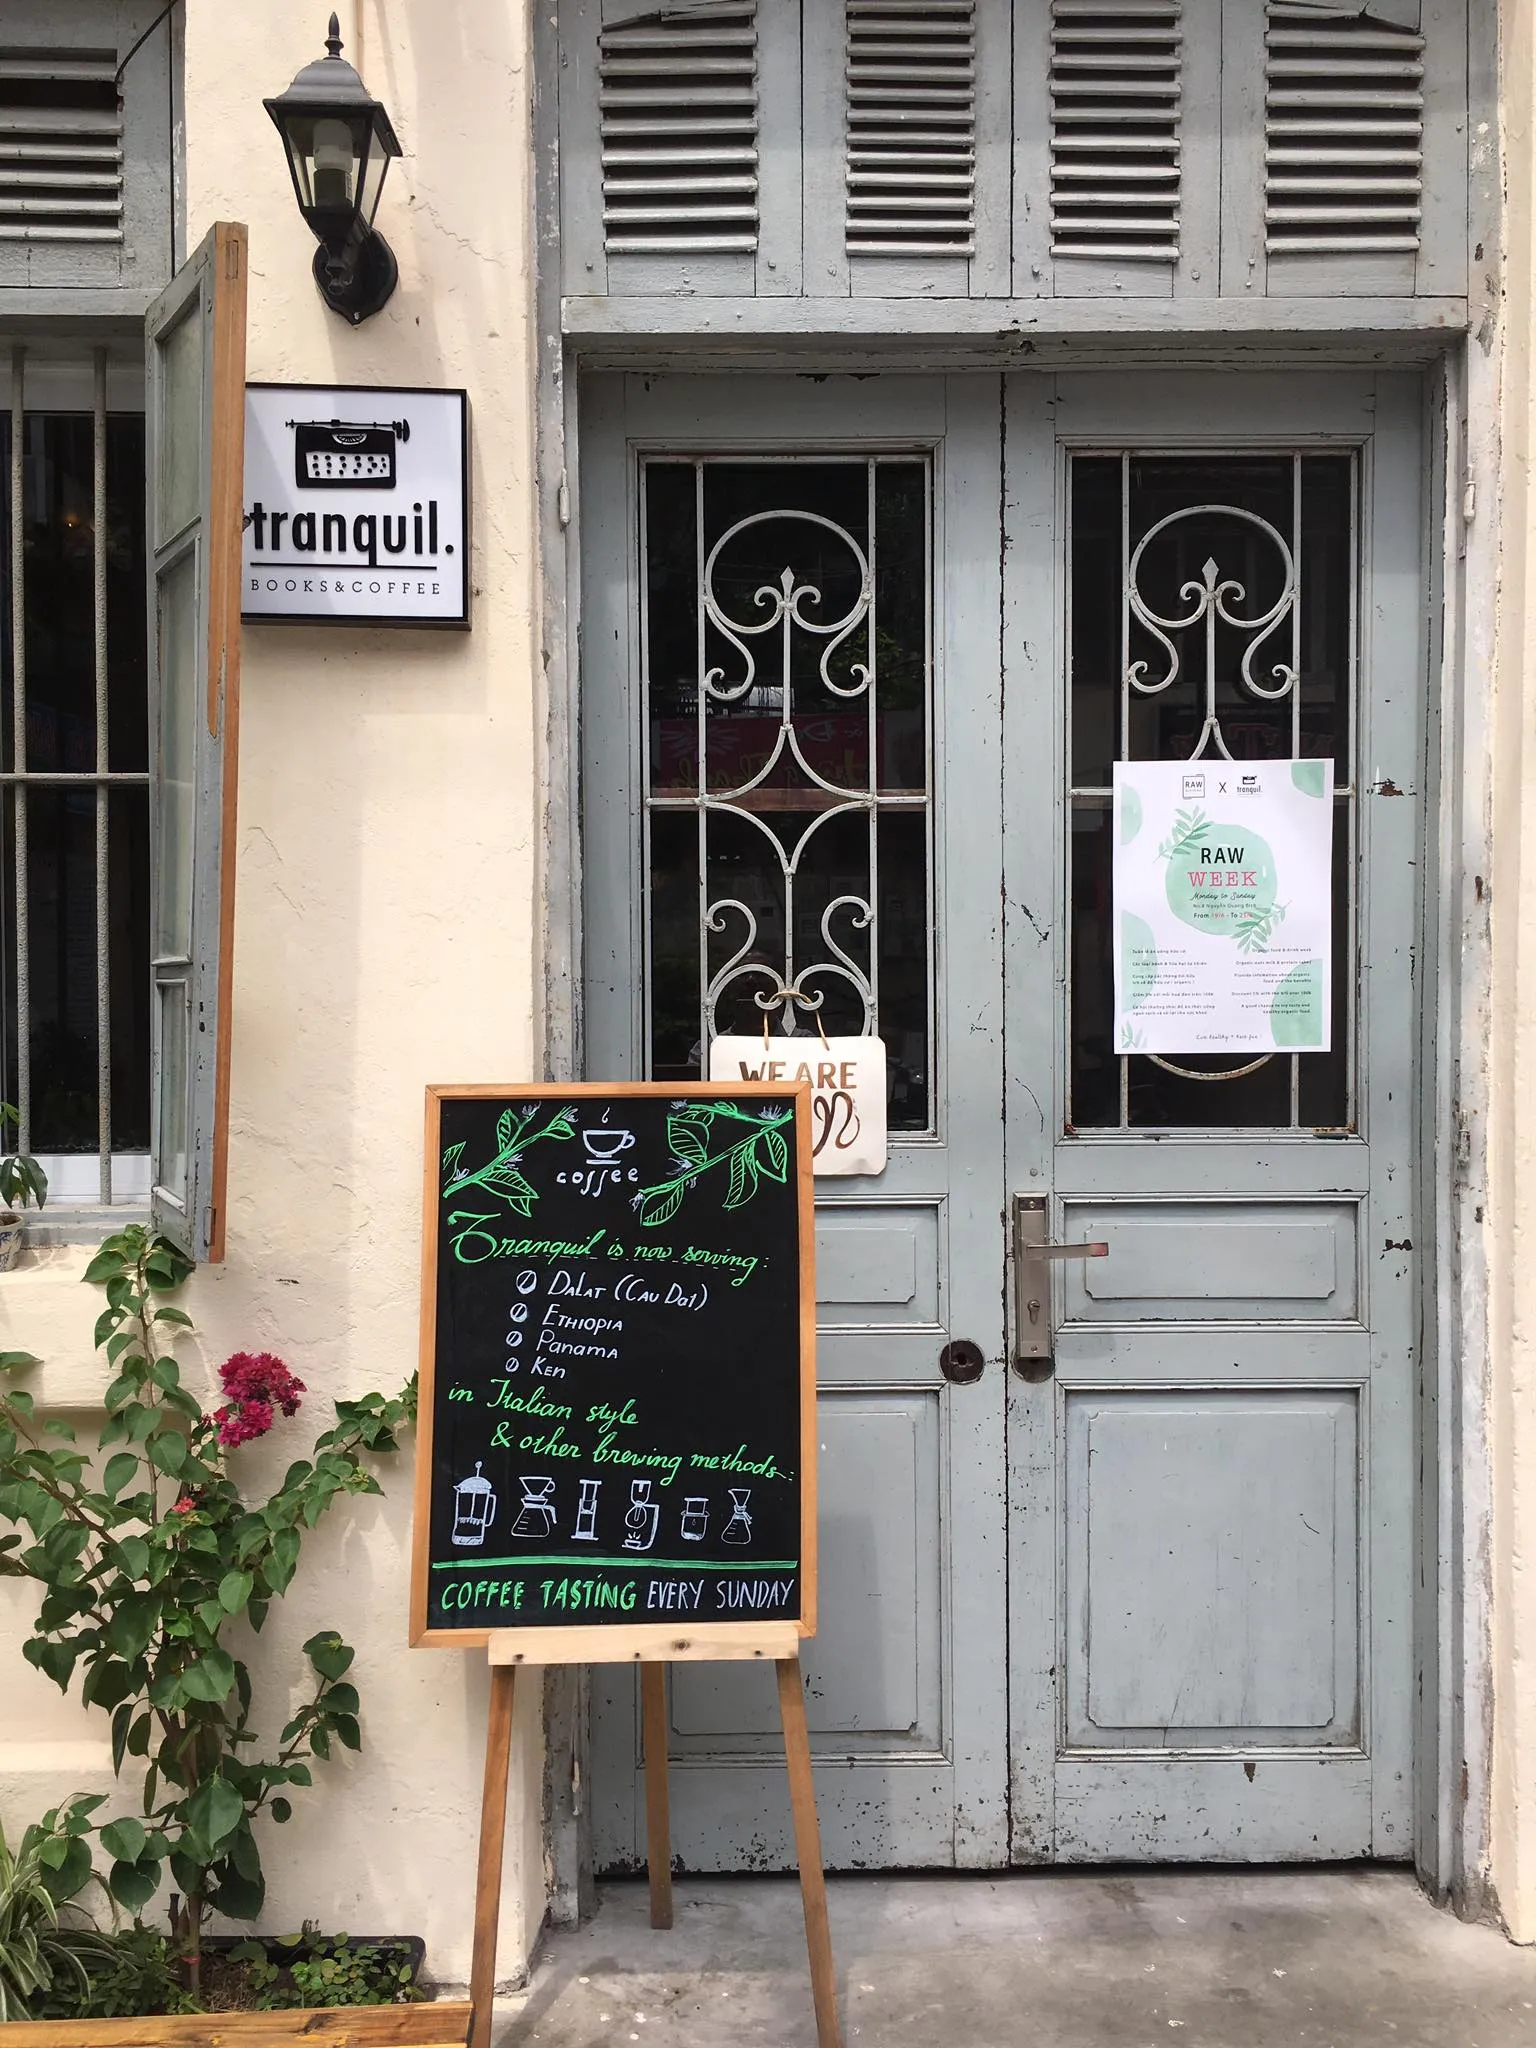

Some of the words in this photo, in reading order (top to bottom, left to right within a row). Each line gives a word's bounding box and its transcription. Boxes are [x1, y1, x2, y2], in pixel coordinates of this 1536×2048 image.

[250, 500, 455, 567] tranquil.
[251, 579, 441, 595] BOOKS&COFFEE
[1200, 847, 1245, 864] RAW
[1187, 871, 1258, 887] WEEK
[738, 1061, 787, 1082] WE
[794, 1062, 858, 1089] ARE
[556, 1167, 640, 1197] coffee
[606, 1237, 624, 1256] is
[634, 1244, 673, 1259] now
[448, 1381, 474, 1401] in
[486, 1379, 573, 1421] Italian
[585, 1399, 640, 1433] style
[490, 1421, 514, 1448] &
[519, 1426, 582, 1458] other
[592, 1431, 683, 1486] brewing
[441, 1580, 525, 1611] COFFEE
[646, 1578, 705, 1610] EVERY
[715, 1578, 795, 1610] SUNDAY
